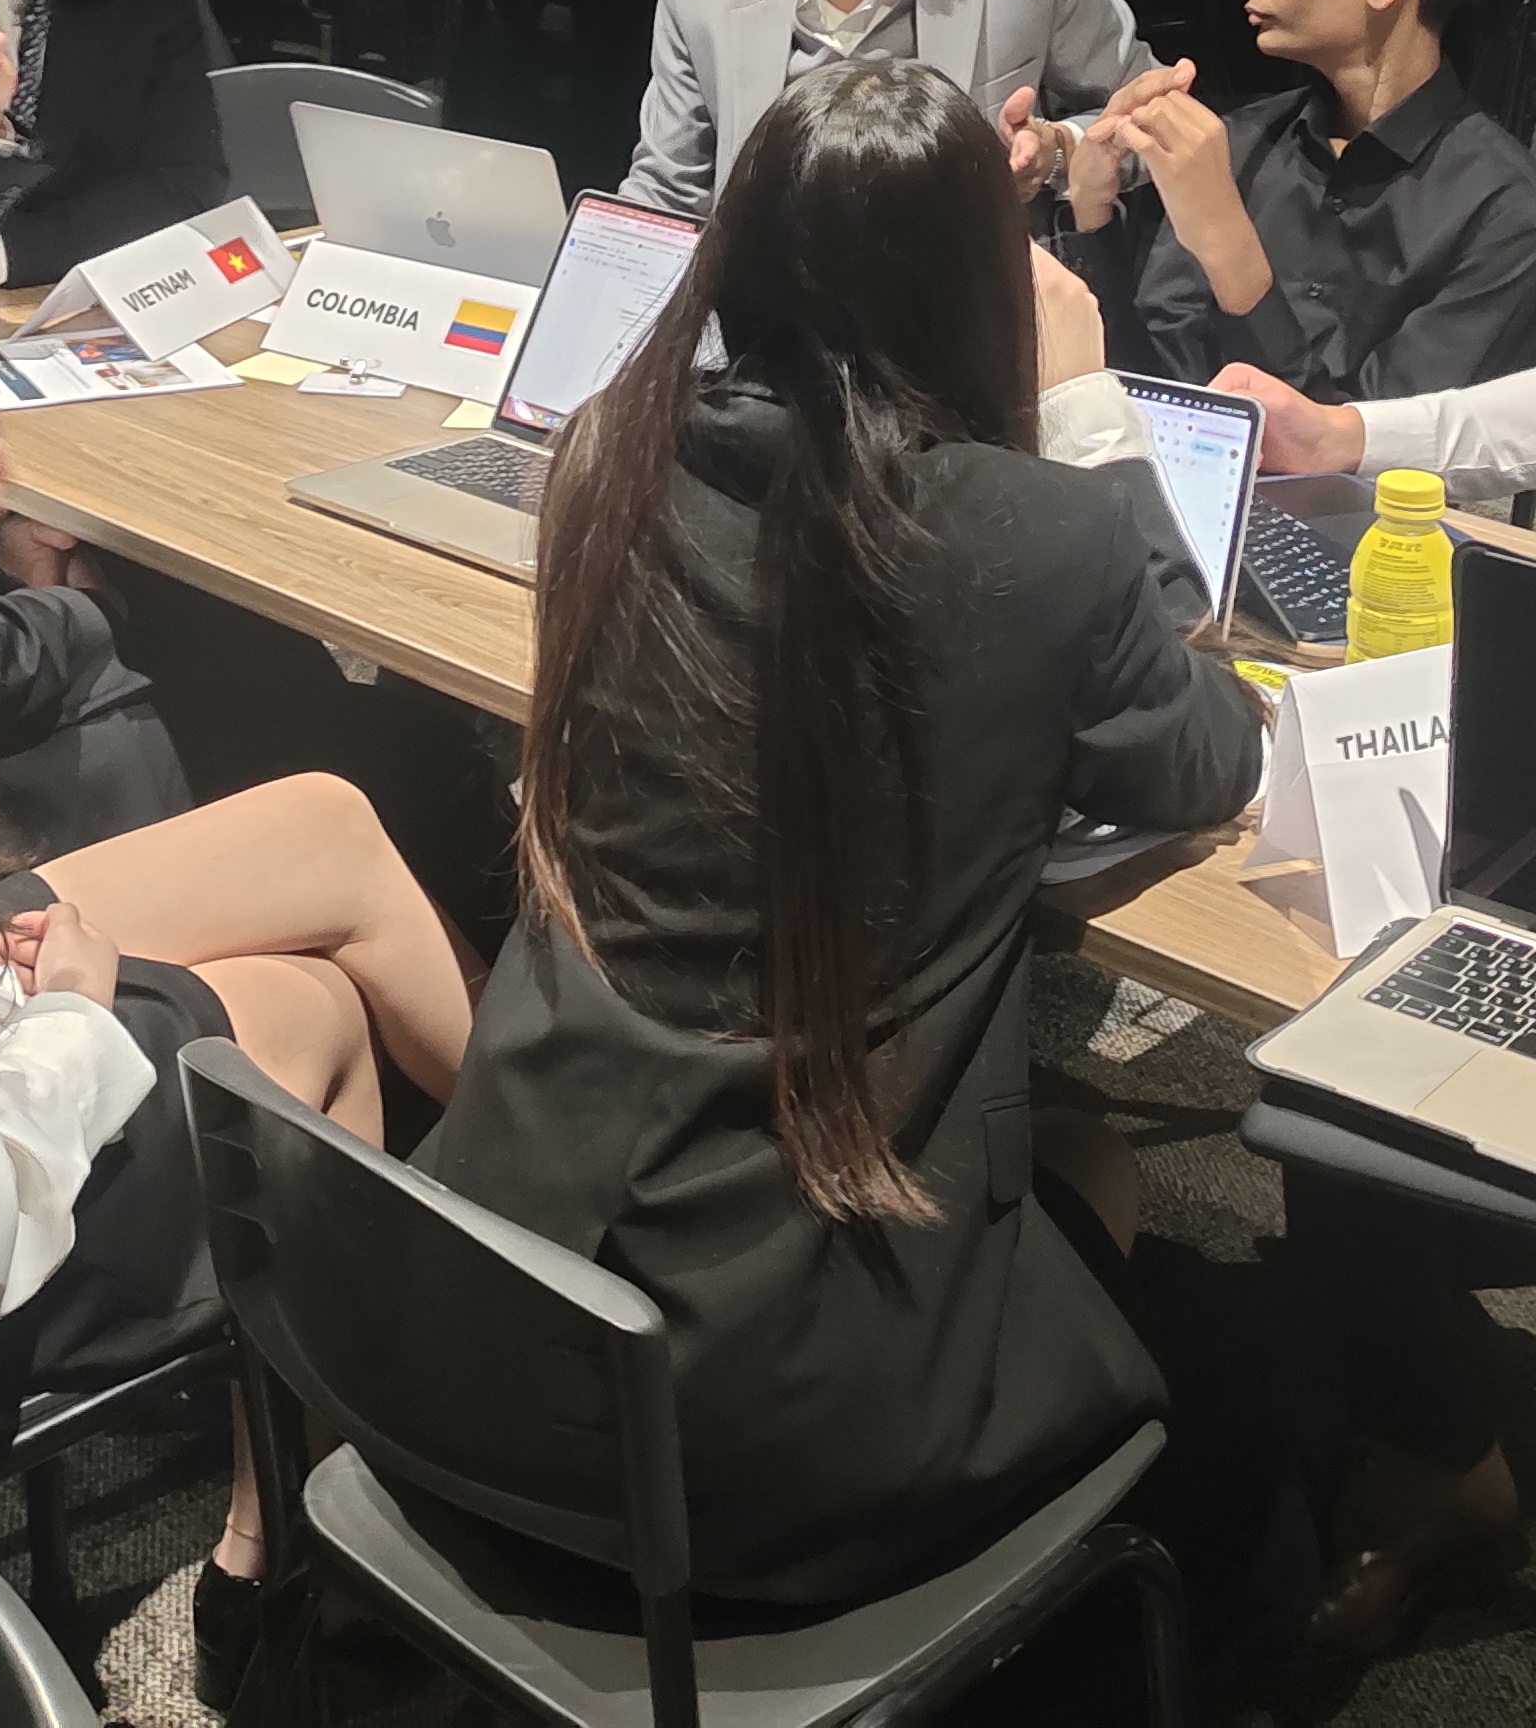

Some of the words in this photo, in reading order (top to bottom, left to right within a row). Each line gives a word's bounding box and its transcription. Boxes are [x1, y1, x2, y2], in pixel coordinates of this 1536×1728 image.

[121, 269, 197, 313] VIETNAM
[306, 288, 420, 332] COLOMBIA
[1335, 715, 1450, 760] THAILA
